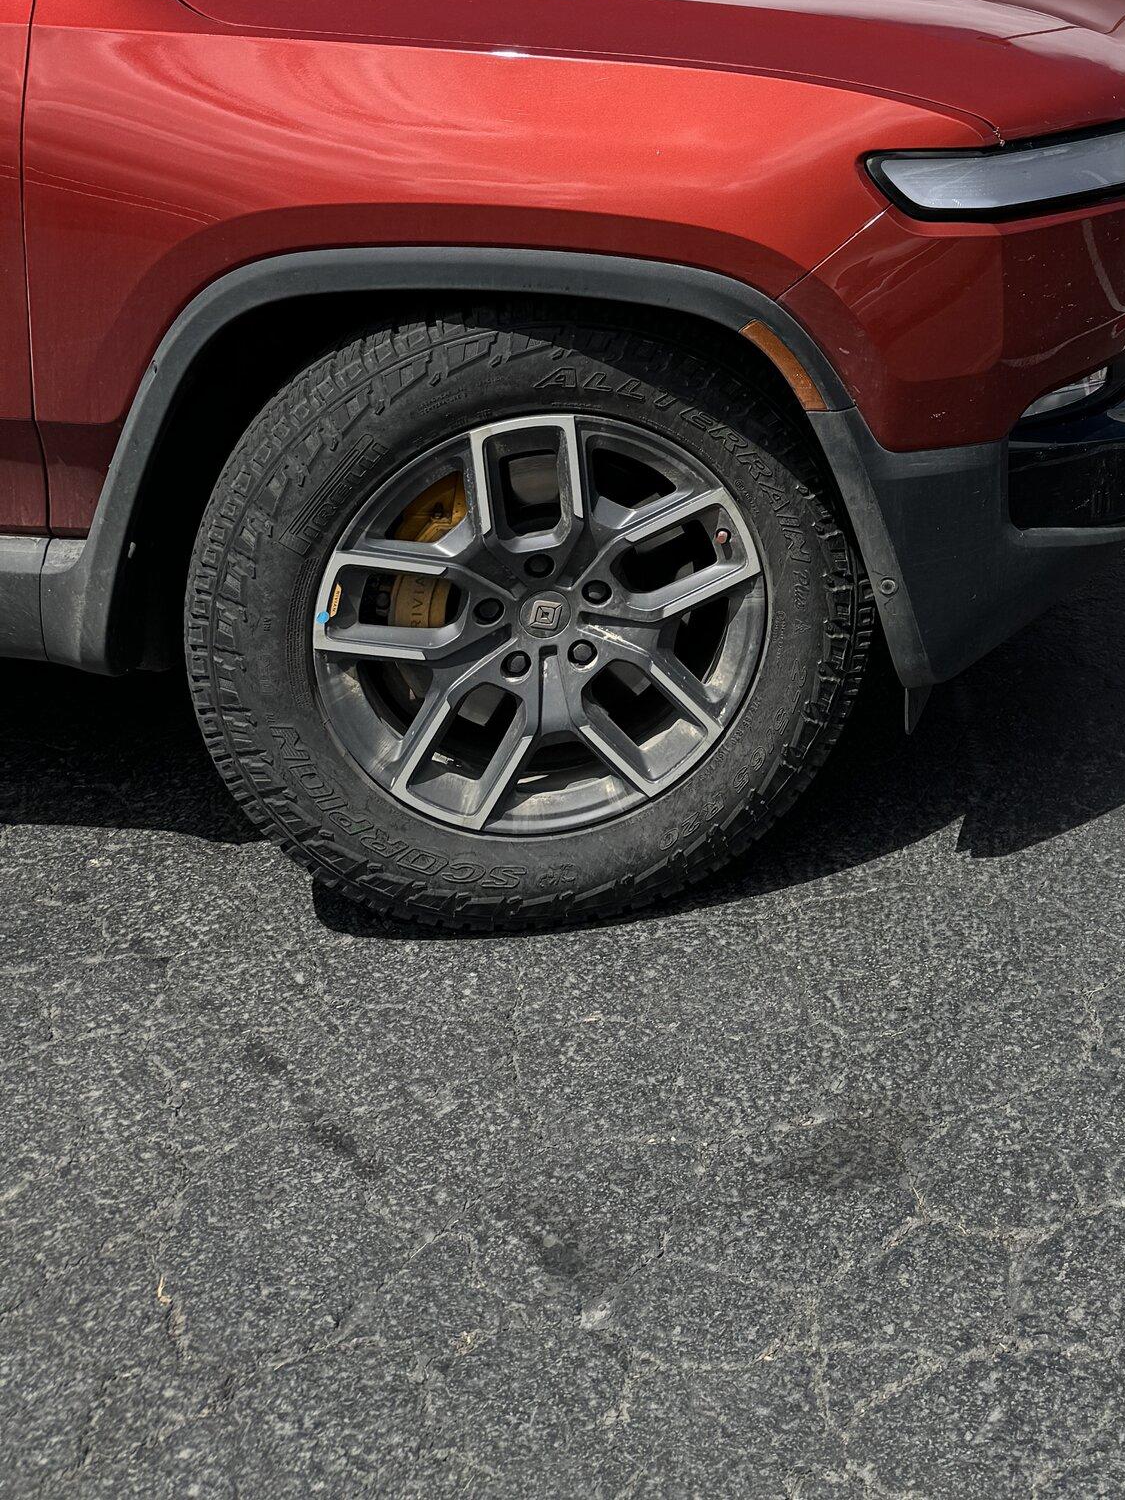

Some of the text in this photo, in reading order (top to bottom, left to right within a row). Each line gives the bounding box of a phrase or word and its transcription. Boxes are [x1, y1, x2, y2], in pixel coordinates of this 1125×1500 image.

[278, 433, 391, 557] PIRELLI
[532, 366, 646, 401] ALL
[653, 386, 812, 564] TERRAIN
[410, 578, 426, 628] RIVIA
[269, 725, 528, 889] SCORPION
[658, 792, 726, 852] R20
